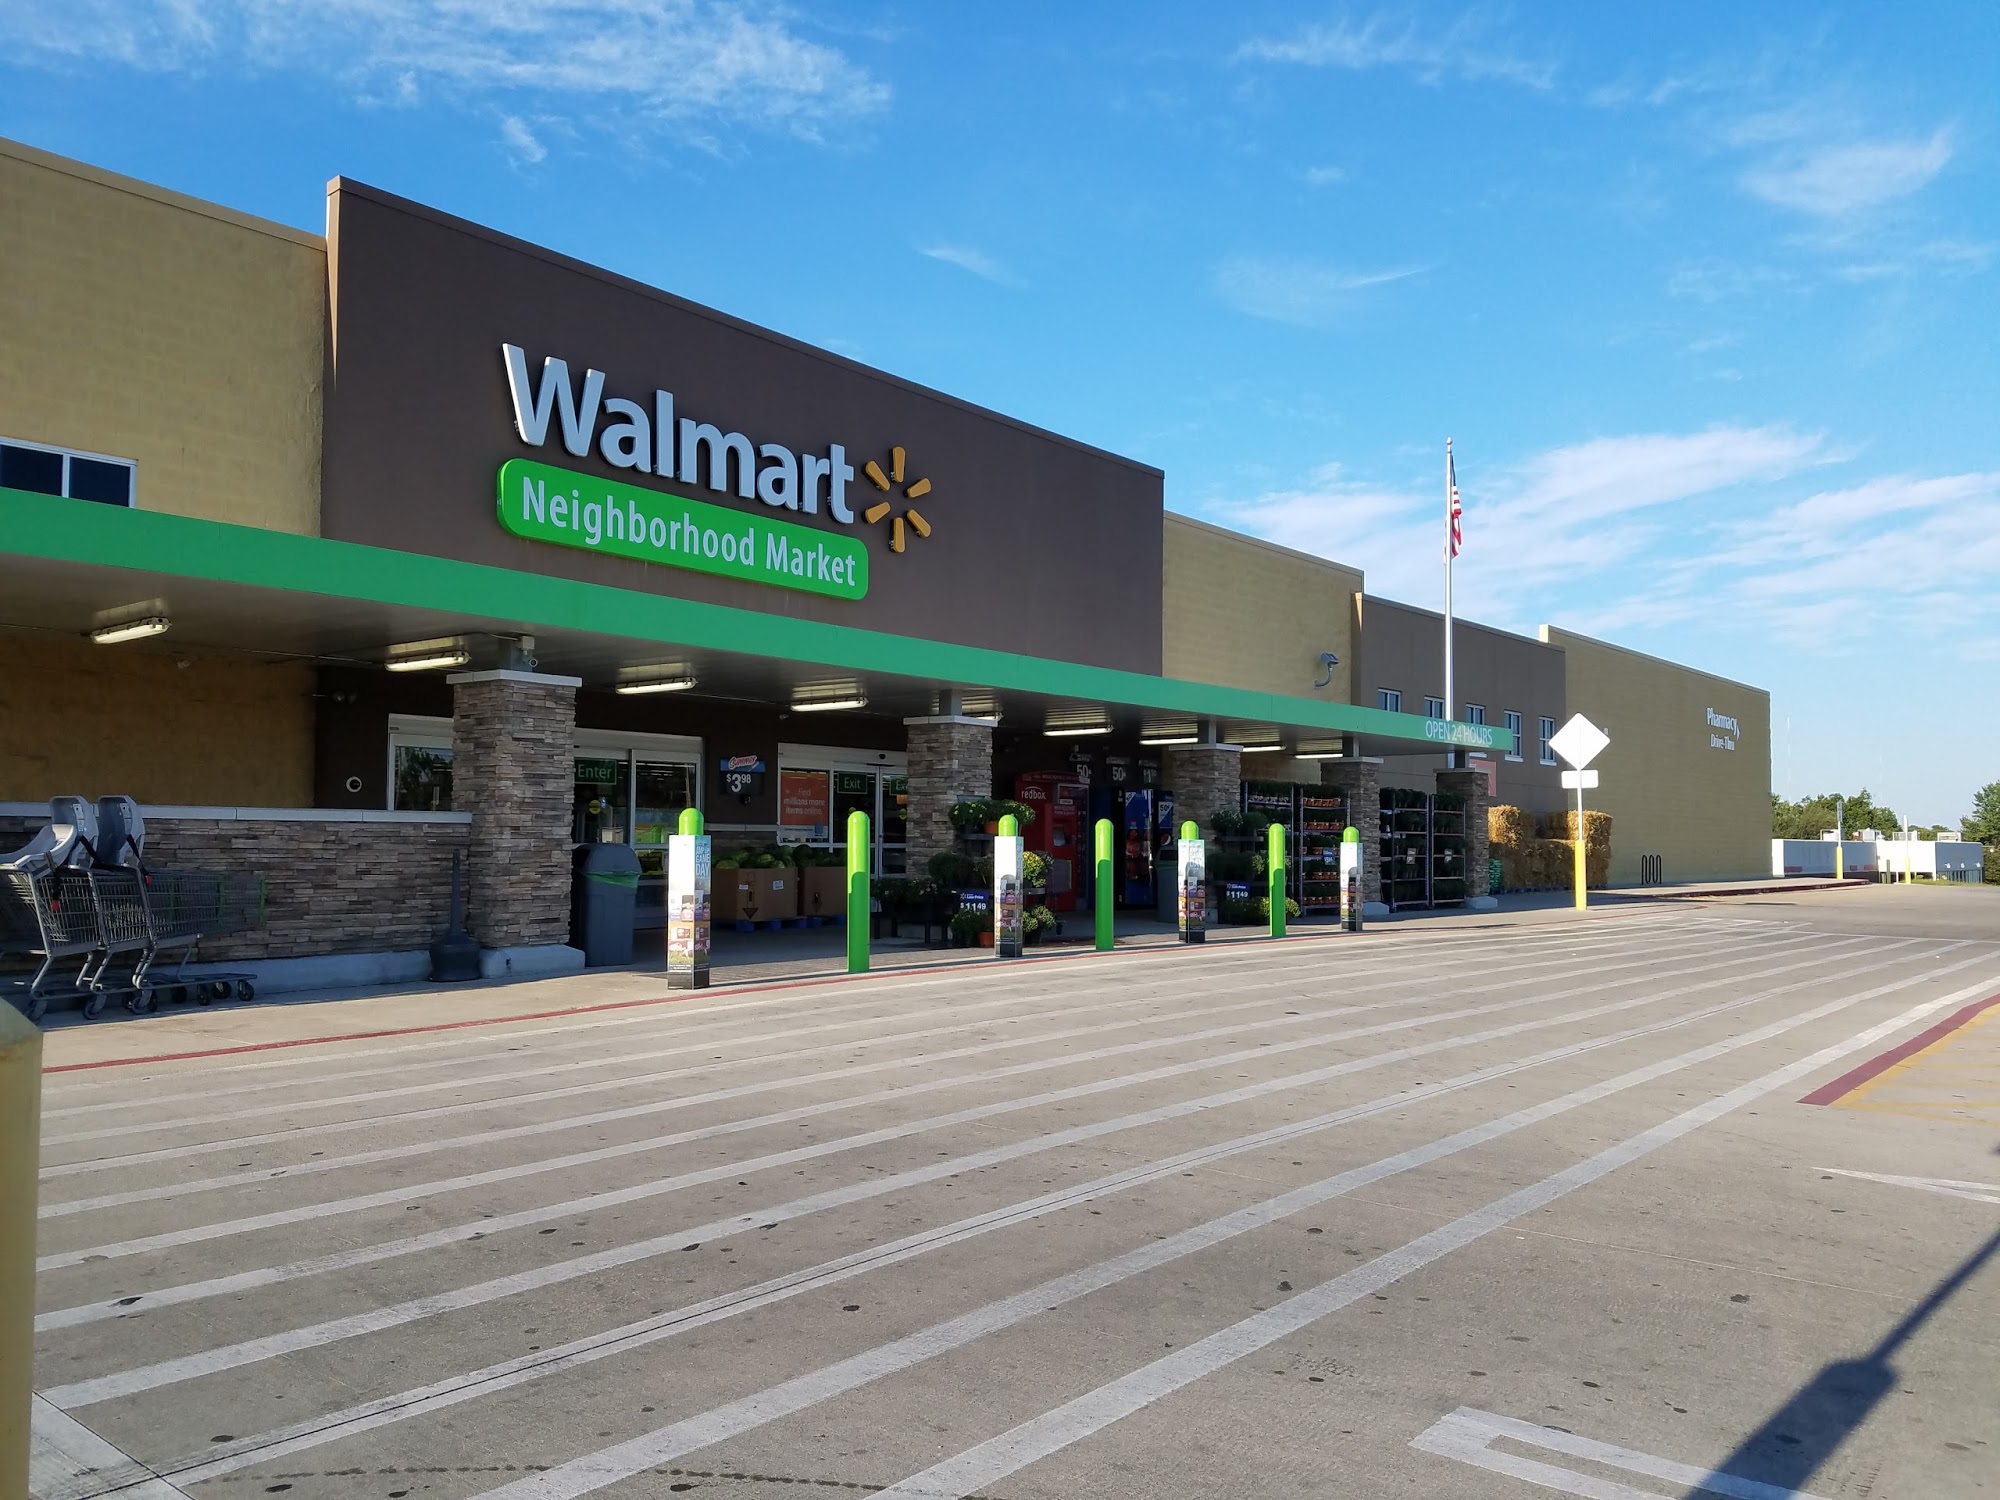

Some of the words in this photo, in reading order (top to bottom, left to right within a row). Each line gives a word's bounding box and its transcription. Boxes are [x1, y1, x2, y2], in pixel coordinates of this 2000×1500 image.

[503, 343, 854, 524] Walmart
[522, 476, 755, 566] Neighborhood
[766, 533, 855, 587] Market
[1706, 708, 1737, 735] Pharmacy
[1426, 720, 1450, 740] OPEN
[1451, 724, 1462, 741] 24
[1463, 725, 1493, 745] HOURS
[578, 764, 612, 779] Enter
[844, 777, 861, 789] Exit
[1021, 788, 1047, 800] redbox
[696, 863, 710, 877] DAY
